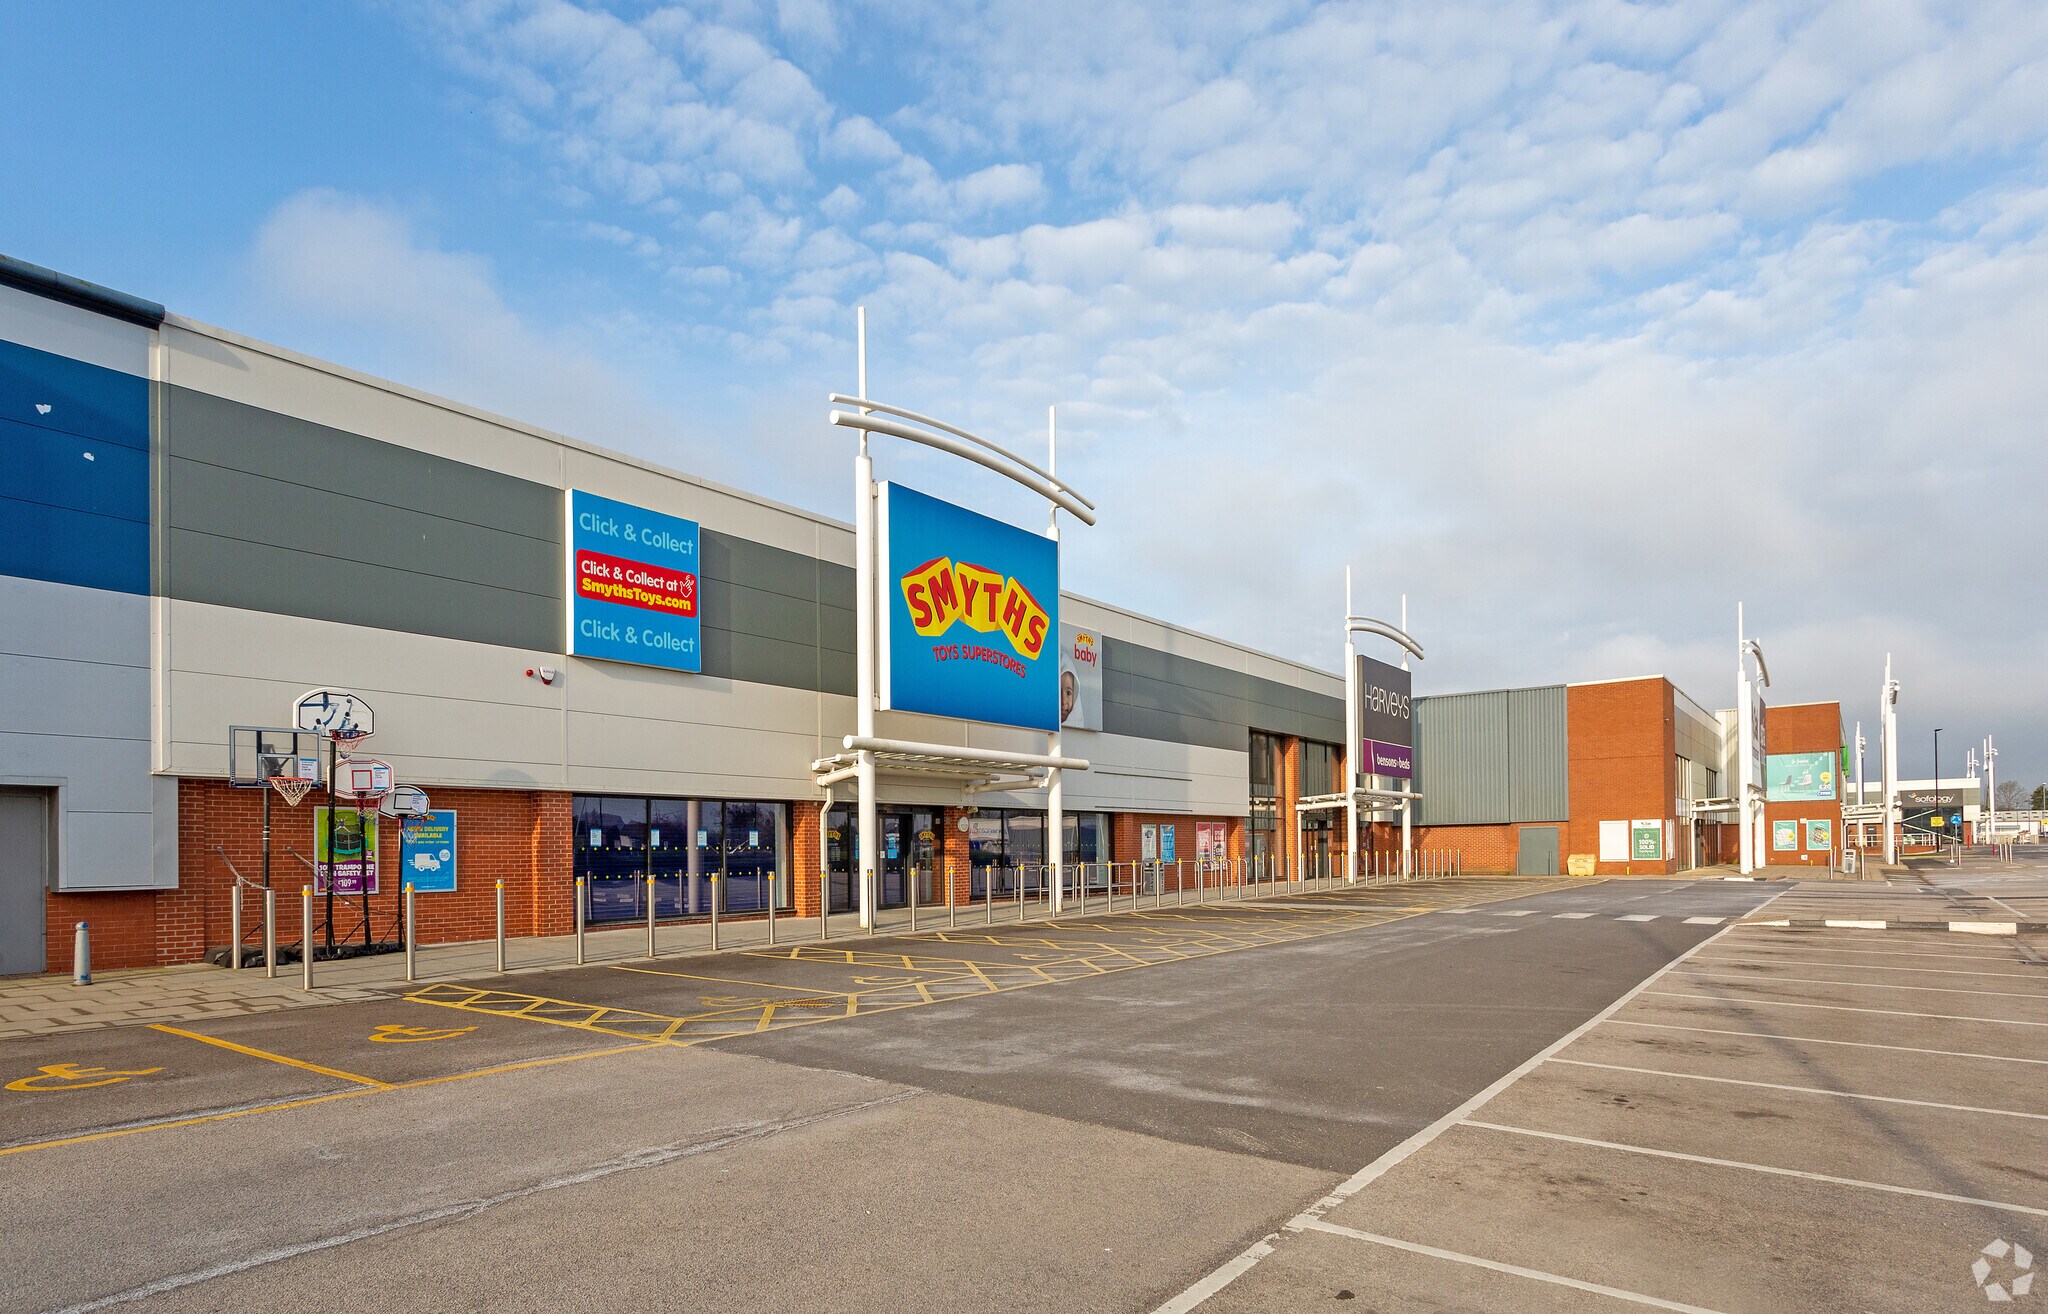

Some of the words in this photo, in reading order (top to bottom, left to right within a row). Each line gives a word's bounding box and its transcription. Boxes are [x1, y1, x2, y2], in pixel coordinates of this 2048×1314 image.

[579, 512, 619, 538] Click
[624, 523, 637, 543] &
[641, 528, 694, 555] Collect
[581, 560, 610, 579] Click
[613, 566, 623, 581] &
[626, 570, 665, 588] Collect
[666, 580, 678, 592] at
[582, 577, 691, 611] SmythsToys.com
[907, 567, 1046, 654] SMYTHS
[580, 619, 620, 642] Click
[625, 626, 638, 644] &
[643, 630, 695, 653] Collect
[932, 644, 959, 662] TOYS
[962, 644, 1027, 678] SUPERSTORES
[1074, 643, 1097, 668] baby
[1915, 794, 1954, 804] sofology
